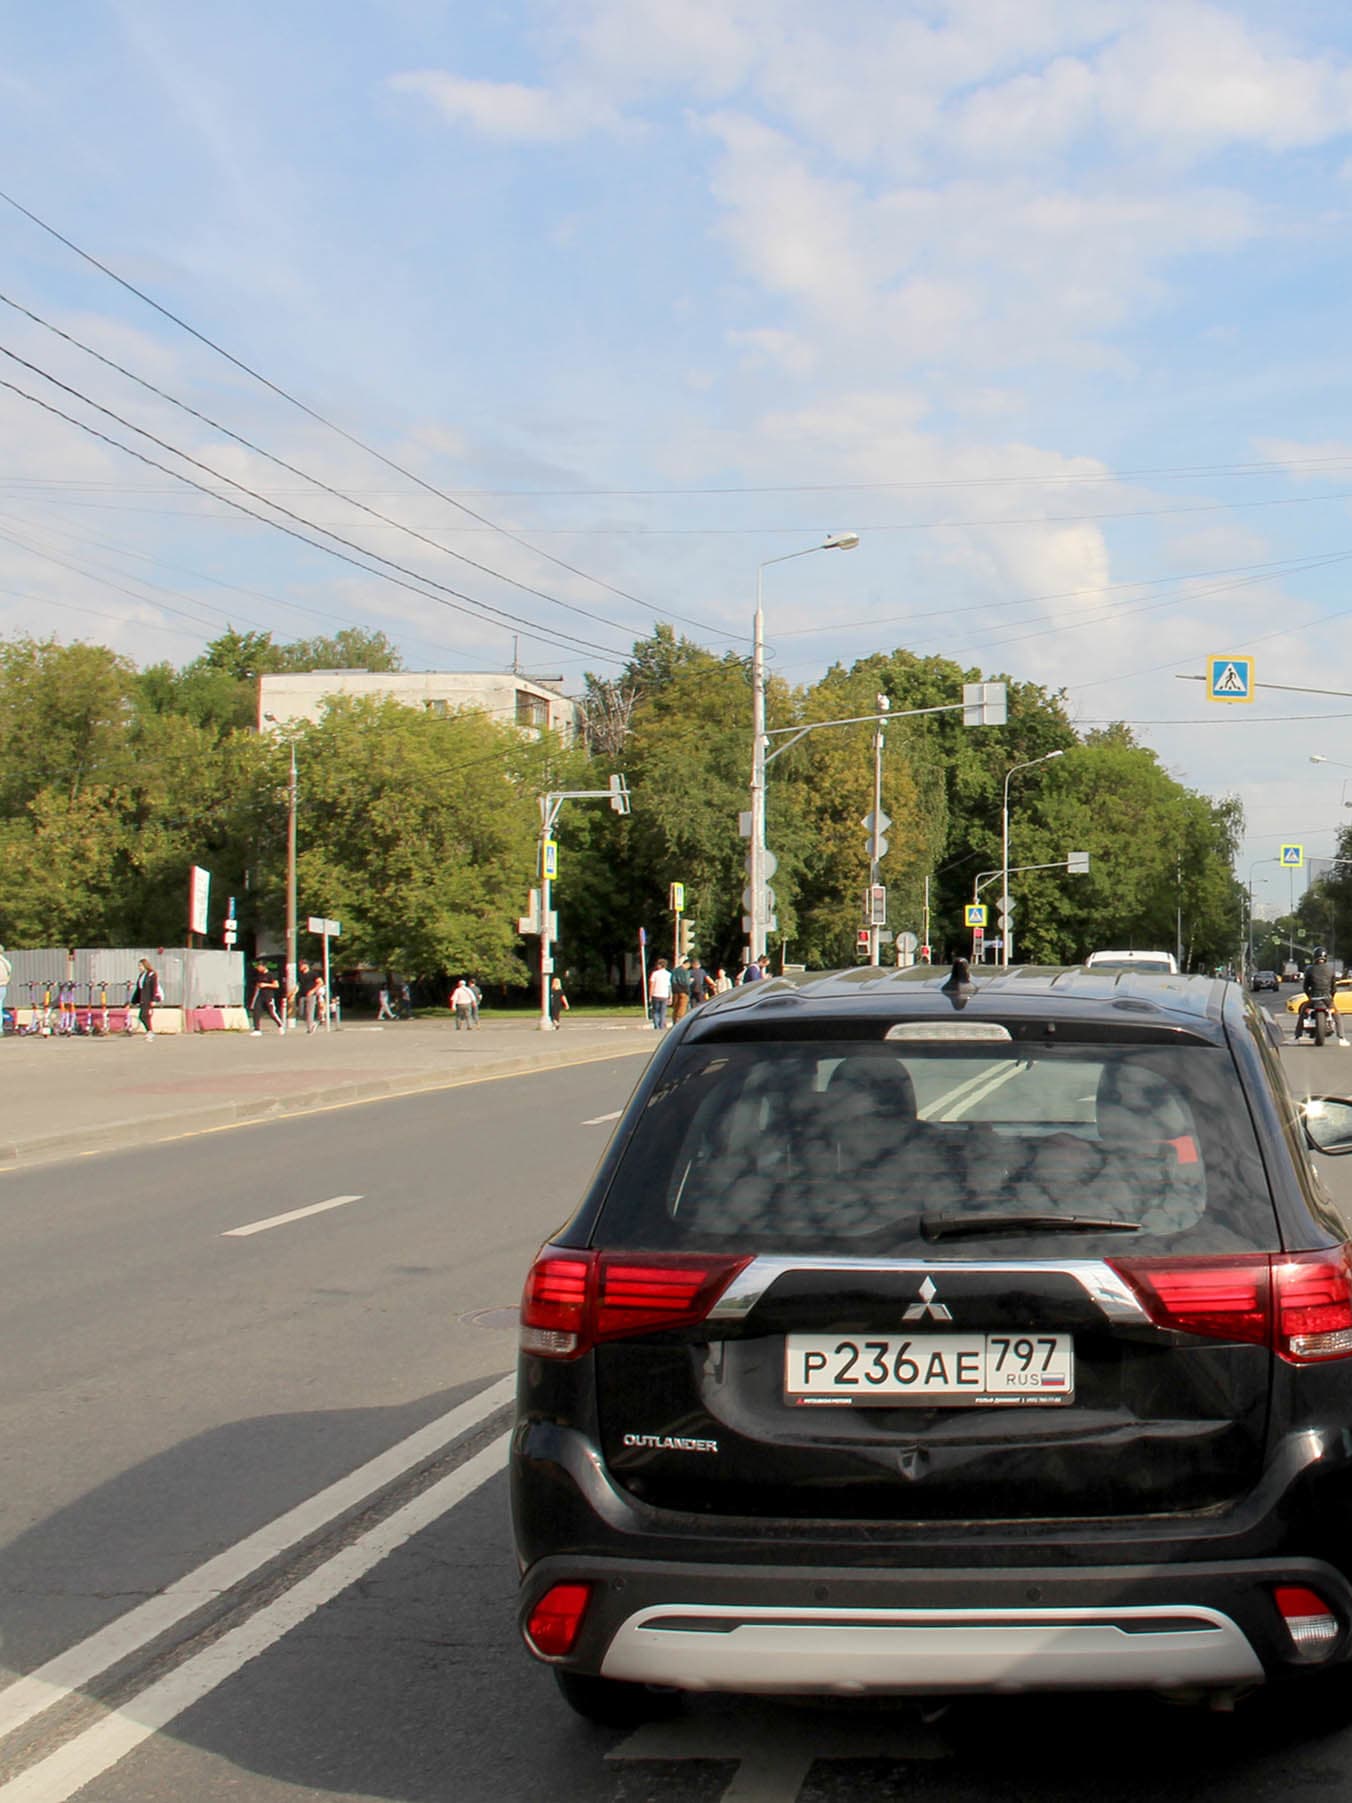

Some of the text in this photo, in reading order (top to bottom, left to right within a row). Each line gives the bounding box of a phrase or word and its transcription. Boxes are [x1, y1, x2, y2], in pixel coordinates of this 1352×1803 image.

[804, 1338, 1057, 1385] Р236АЕ 797
[1006, 1373, 1040, 1385] RUS
[623, 1434, 718, 1453] OUTLANDER
